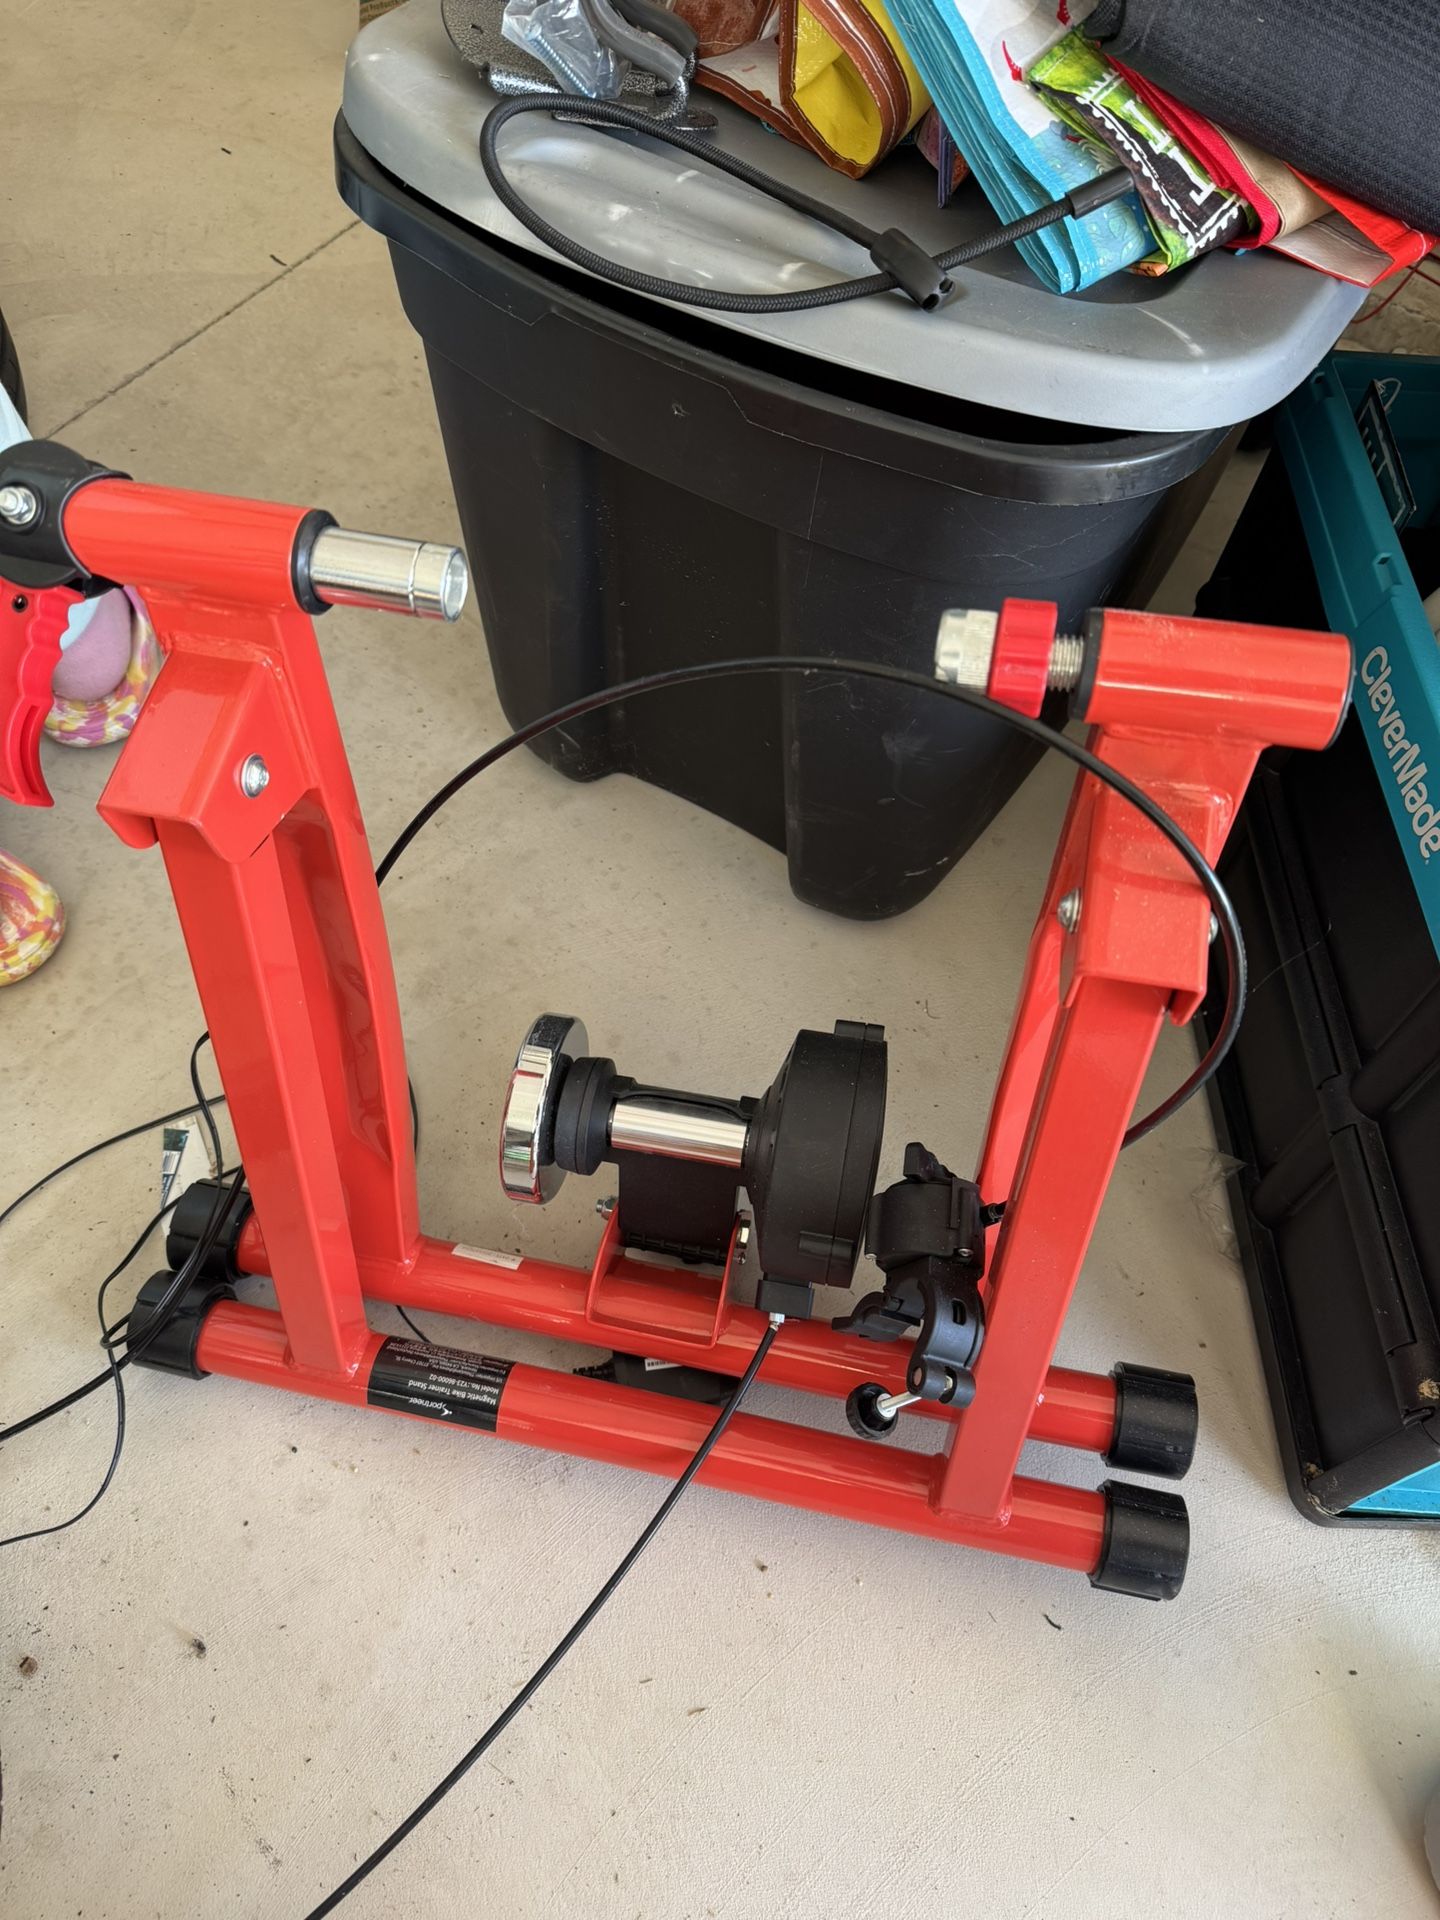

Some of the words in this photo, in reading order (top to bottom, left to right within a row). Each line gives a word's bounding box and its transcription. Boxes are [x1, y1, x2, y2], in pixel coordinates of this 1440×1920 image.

[1361, 645, 1440, 858] CleverMade
[408, 1379, 427, 1390] Stand
[428, 1383, 451, 1395] Trainer
[480, 1384, 499, 1395] Model
[451, 1387, 466, 1399] Bike
[467, 1391, 497, 1406] Magnetic
